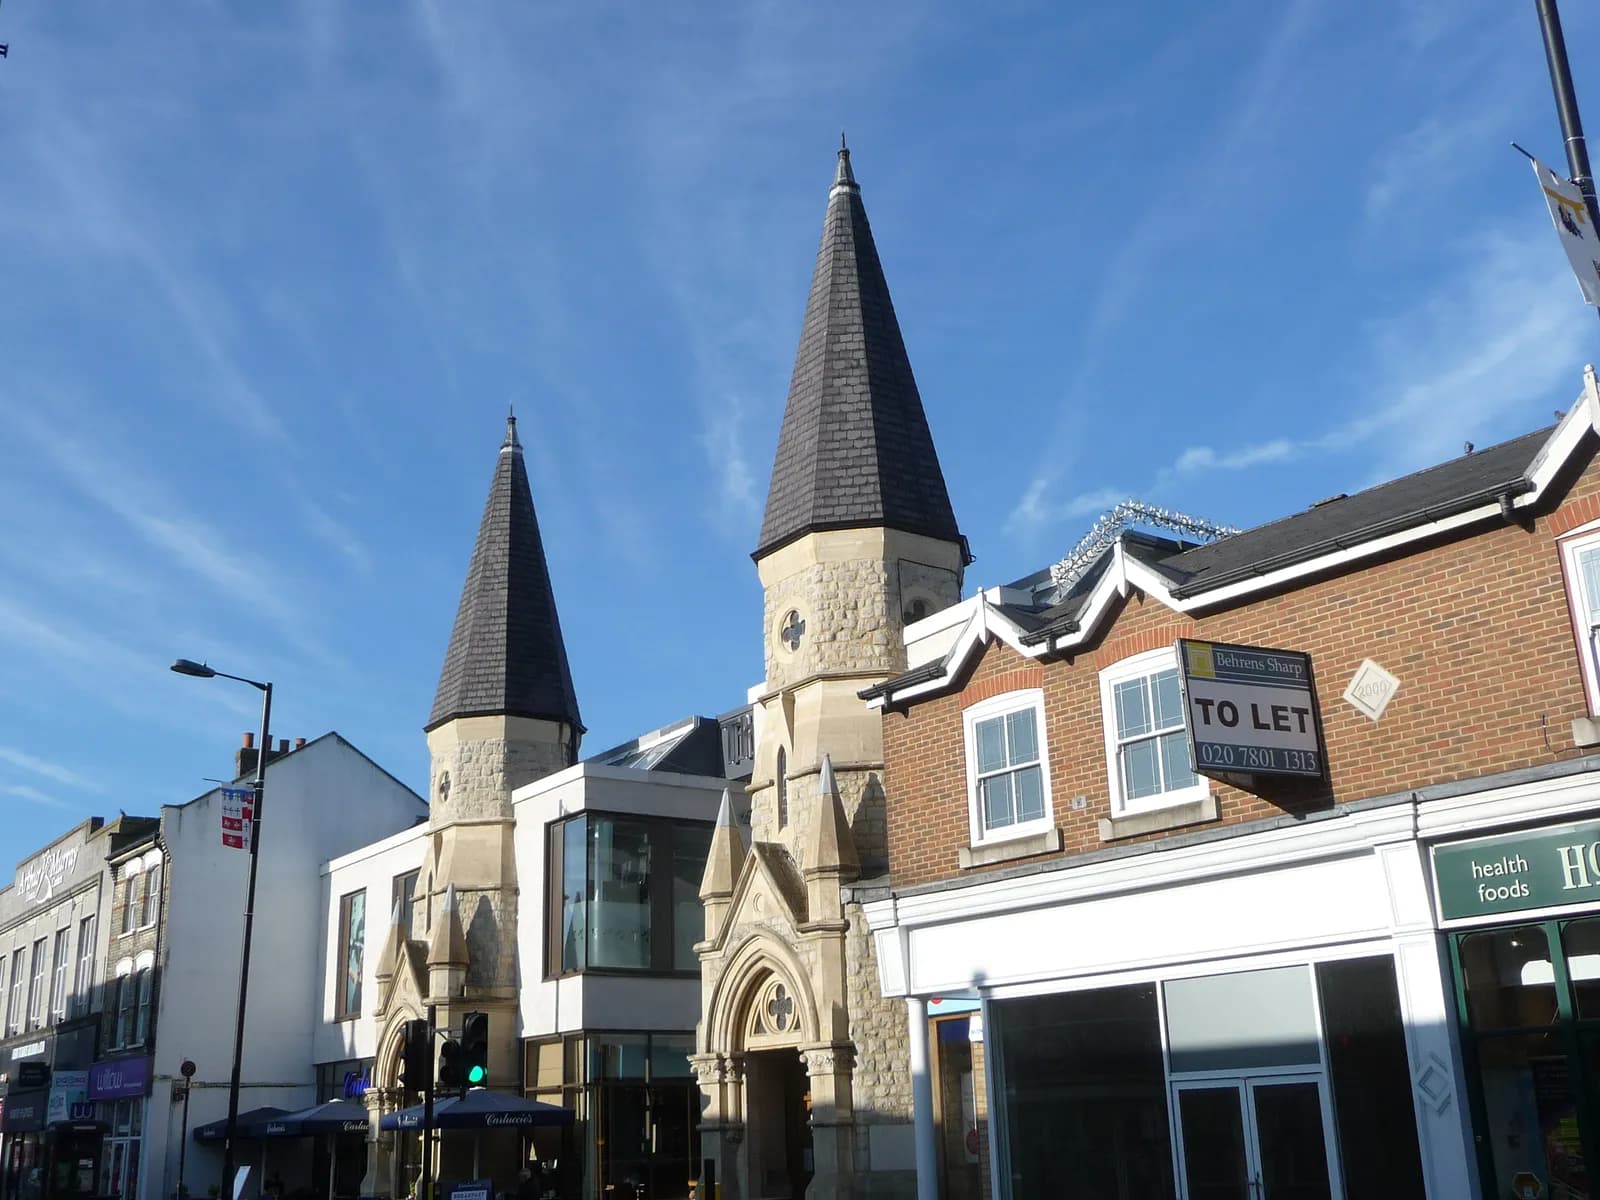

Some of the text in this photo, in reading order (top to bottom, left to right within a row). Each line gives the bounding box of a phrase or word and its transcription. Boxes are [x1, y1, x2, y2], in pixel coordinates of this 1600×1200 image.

[1216, 651, 1303, 678] Behrens Sharp
[1195, 698, 1309, 733] TO LET
[1202, 744, 1317, 771] 020 7801 1313
[1472, 854, 1529, 879] health
[1479, 880, 1530, 902] foods
[485, 1113, 533, 1126] Carluccio's
